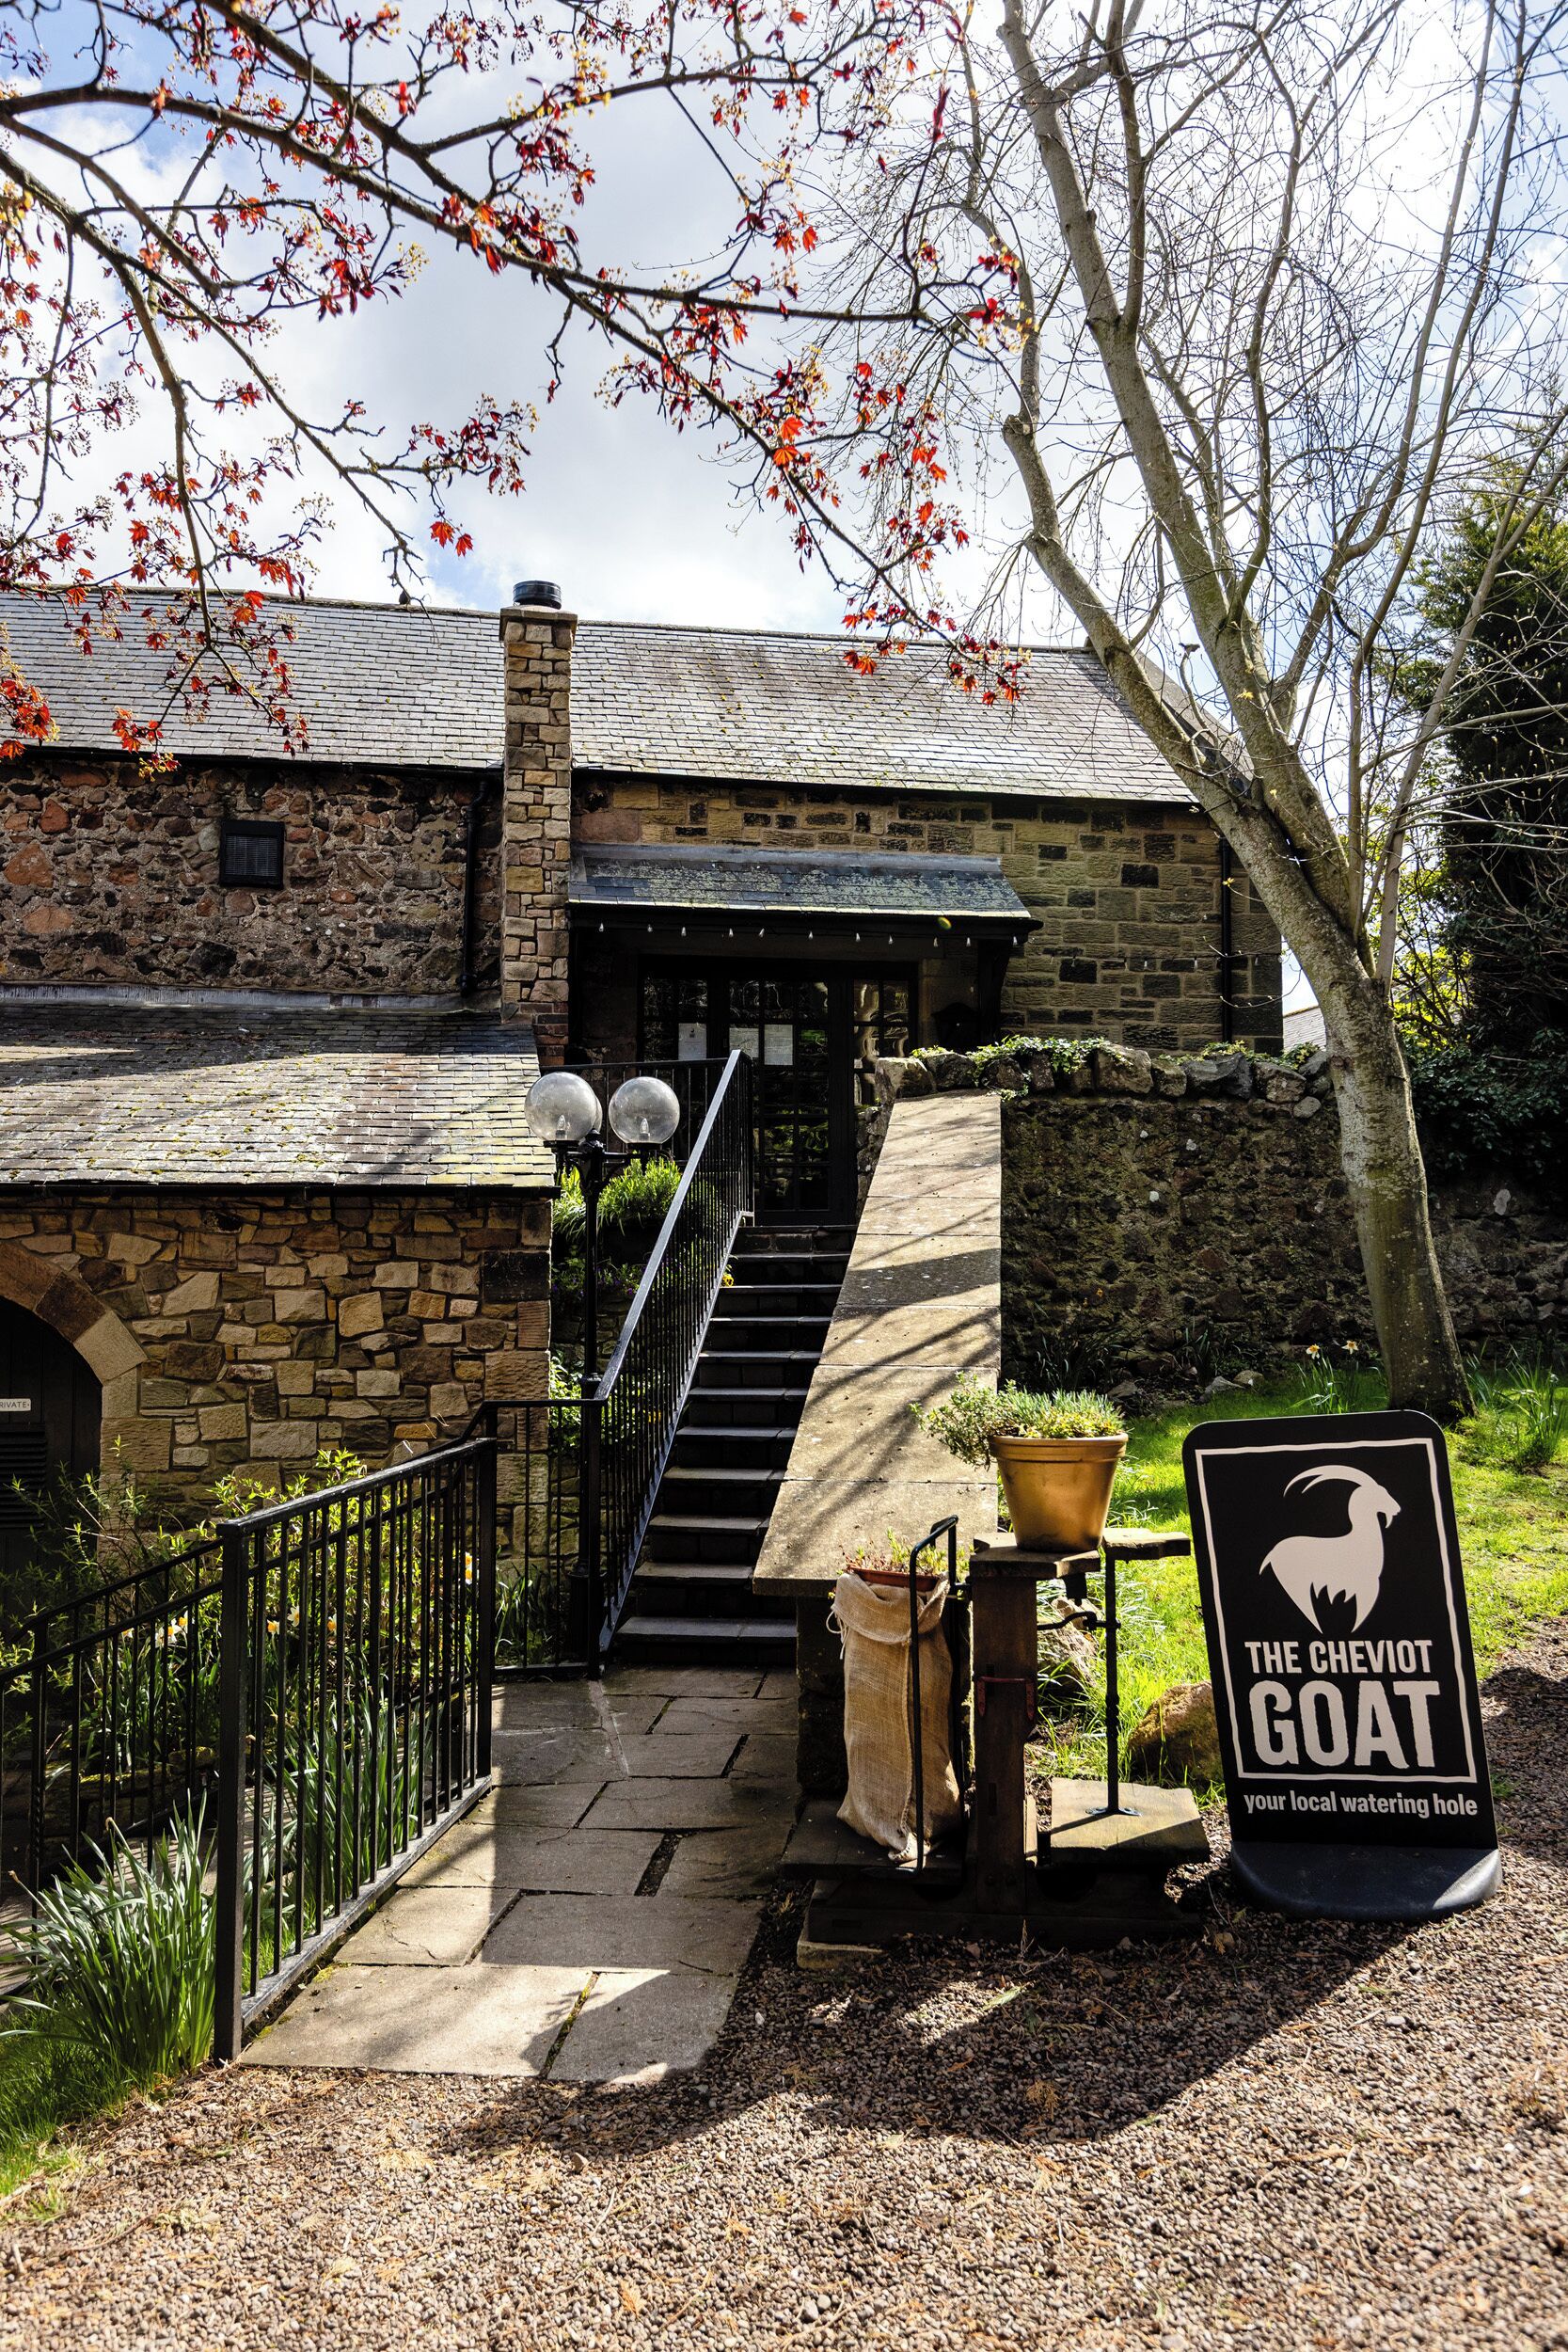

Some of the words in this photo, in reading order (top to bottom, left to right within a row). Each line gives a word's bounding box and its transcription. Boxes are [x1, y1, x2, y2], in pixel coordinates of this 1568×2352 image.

[1244, 1641, 1302, 1674] THE
[1308, 1640, 1433, 1674] CHEVIOT
[1249, 1679, 1441, 1769] GOAT
[1243, 1794, 1287, 1814] your
[1290, 1789, 1338, 1812] local
[1340, 1792, 1430, 1819] watering
[1433, 1793, 1478, 1816] hole
